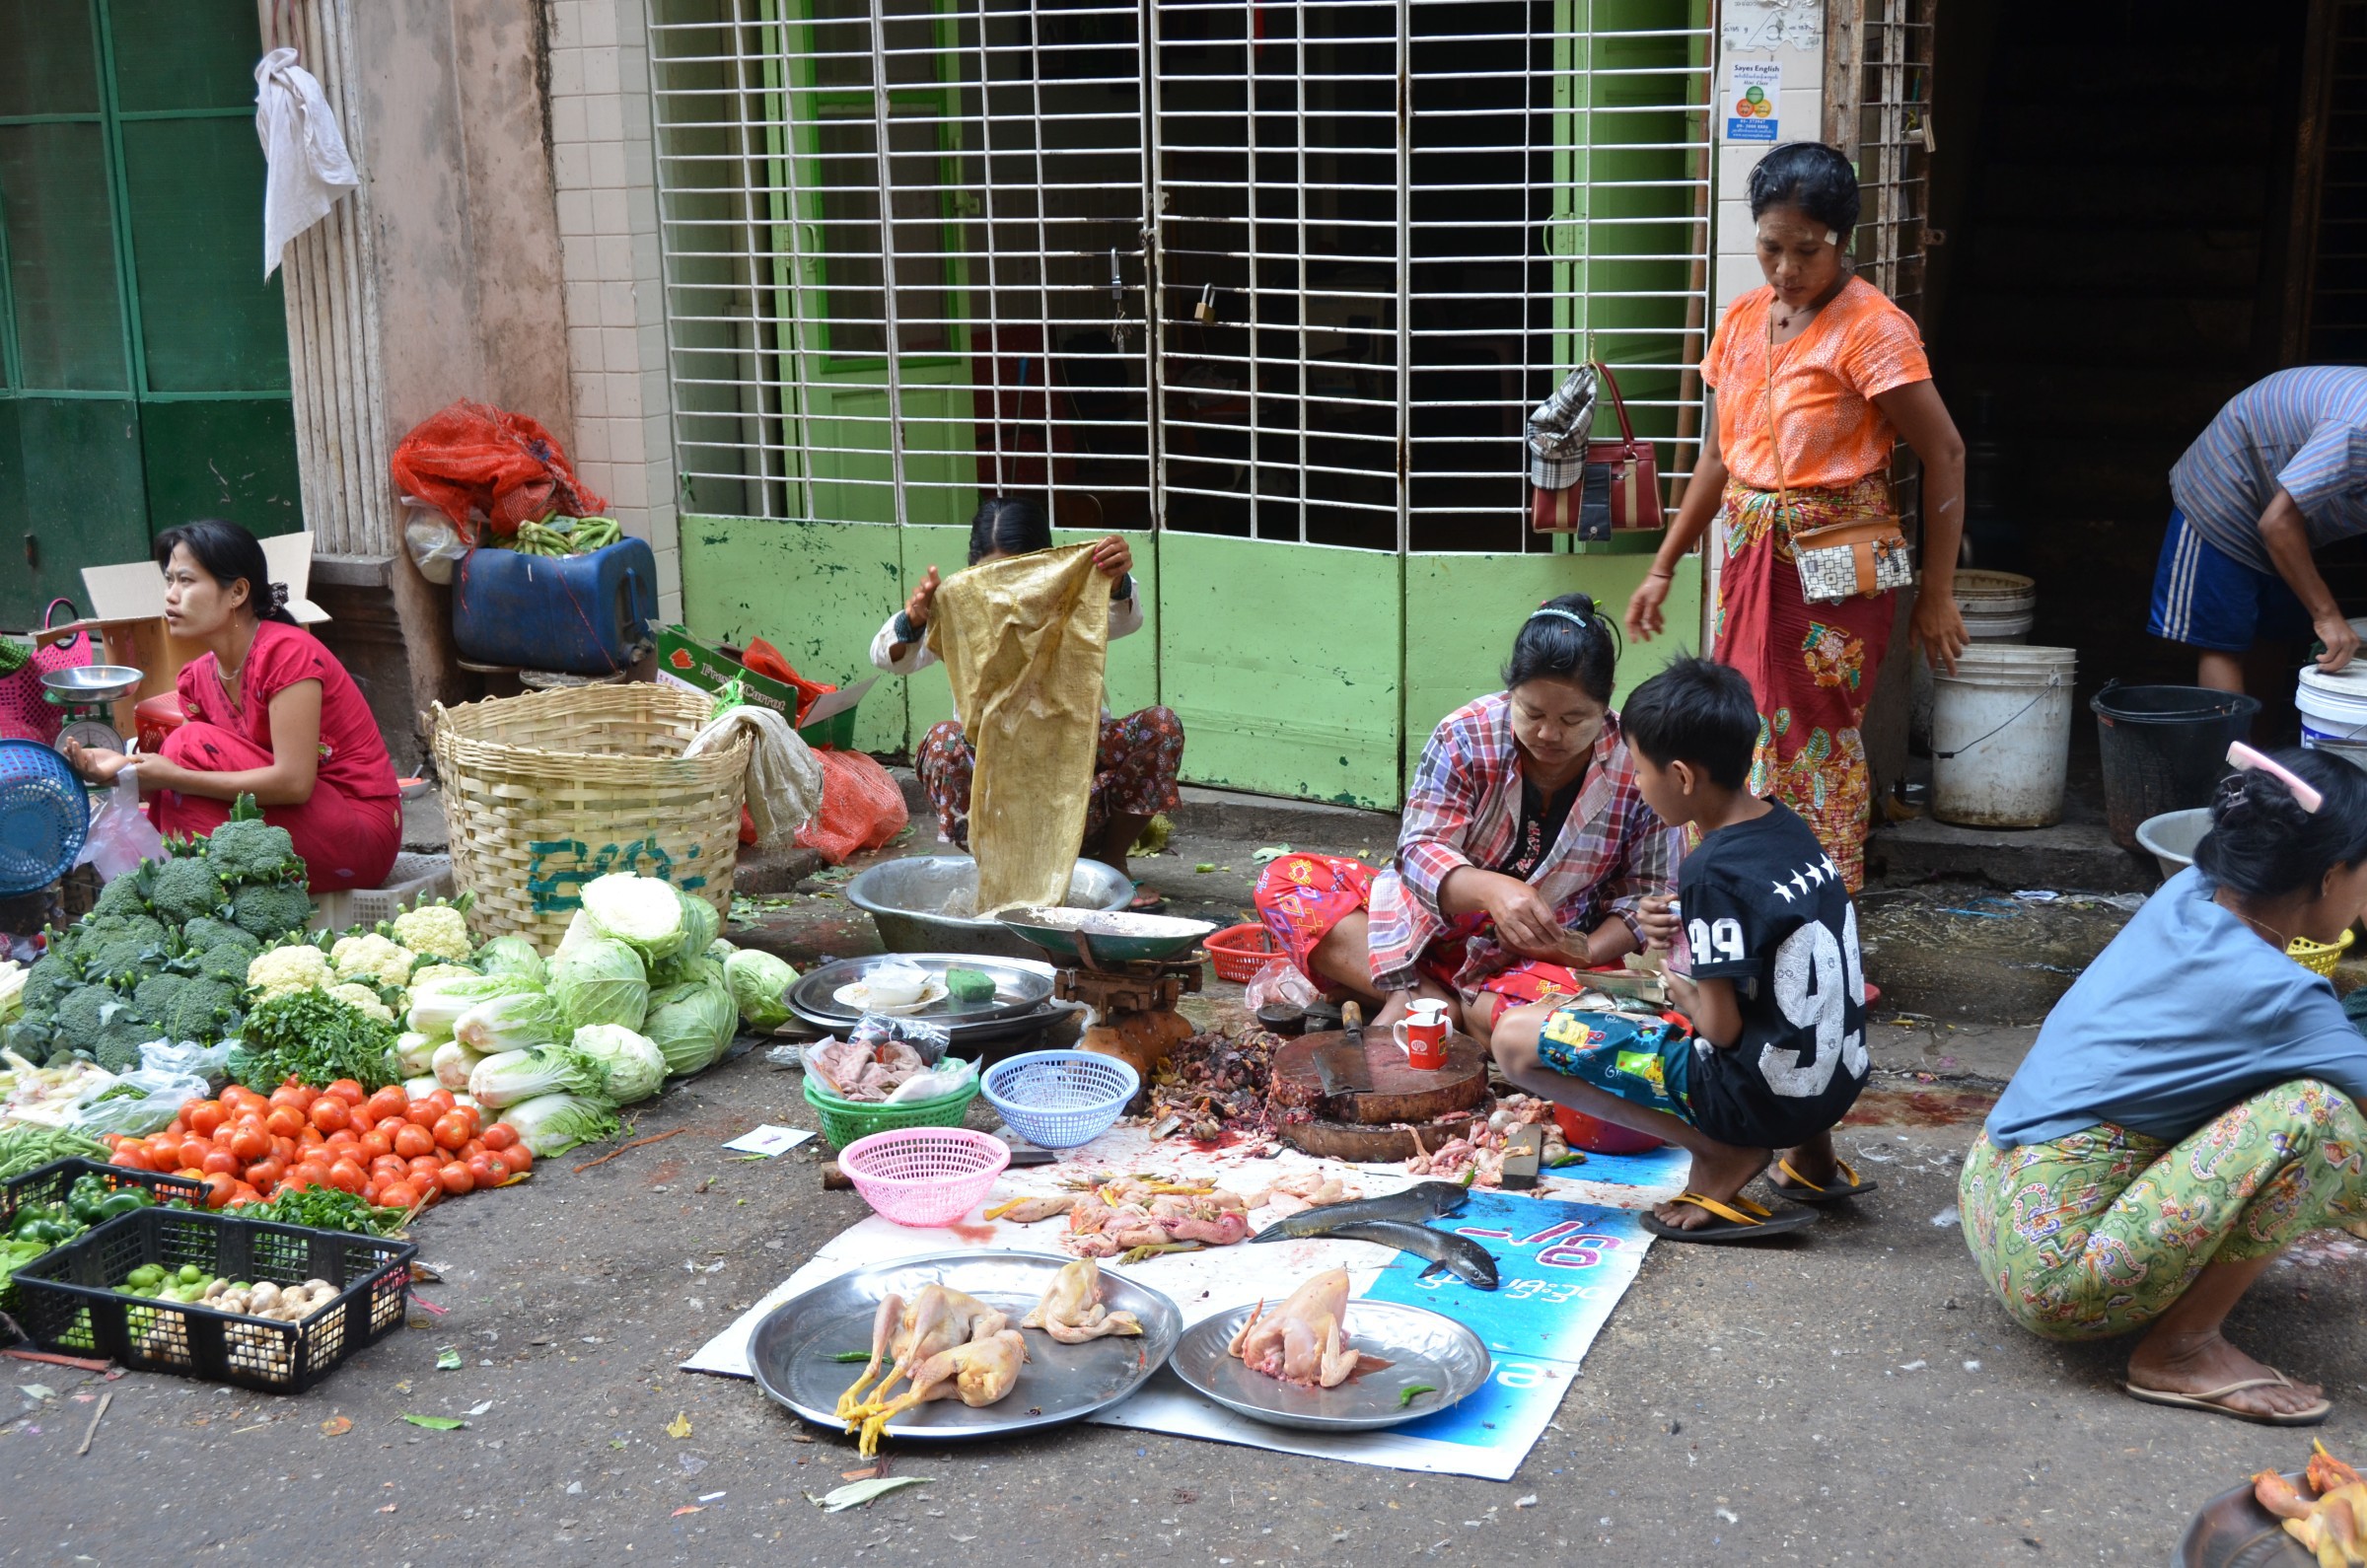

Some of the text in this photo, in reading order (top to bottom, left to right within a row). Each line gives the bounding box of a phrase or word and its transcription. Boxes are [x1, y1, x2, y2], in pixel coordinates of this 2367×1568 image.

[1755, 65, 1780, 74] English
[744, 683, 786, 711] Carrot
[1688, 917, 1745, 964] 99
